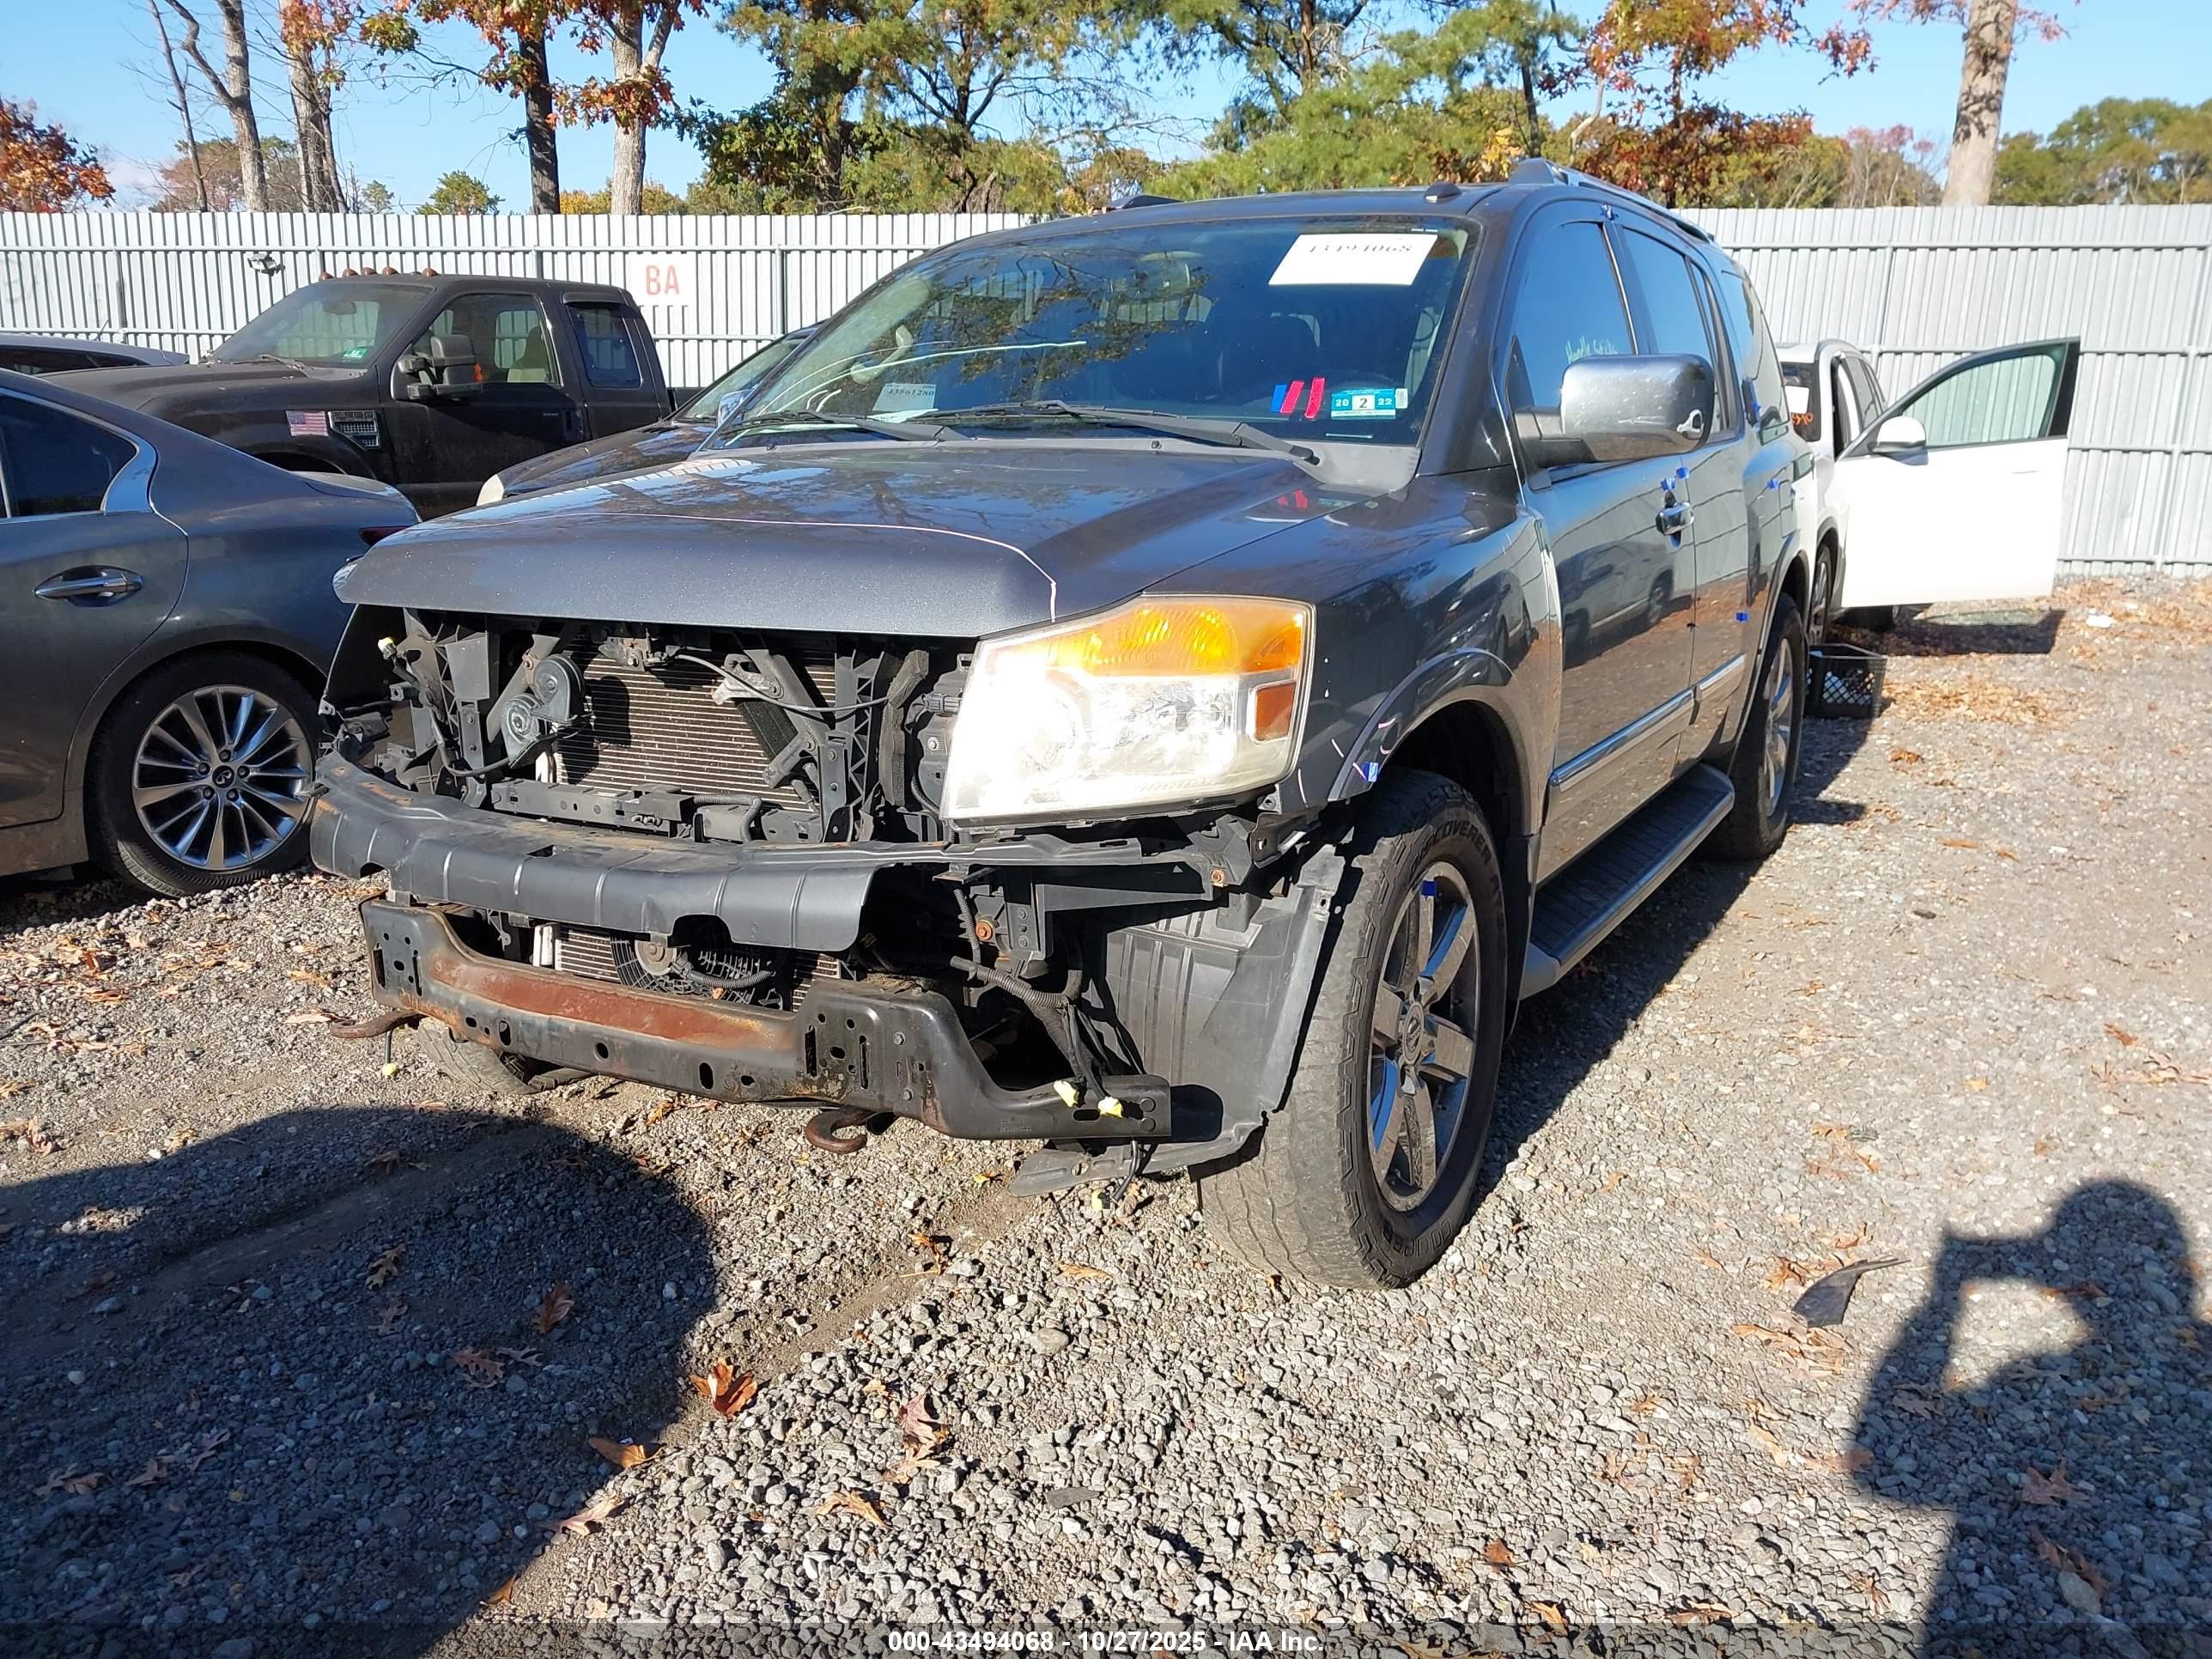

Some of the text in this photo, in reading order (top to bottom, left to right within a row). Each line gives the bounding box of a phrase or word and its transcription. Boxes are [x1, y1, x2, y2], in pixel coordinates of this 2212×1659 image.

[646, 264, 680, 295] BA
[1335, 398, 1350, 407] 20
[1359, 398, 1368, 409] 2
[1377, 398, 1392, 406] 22
